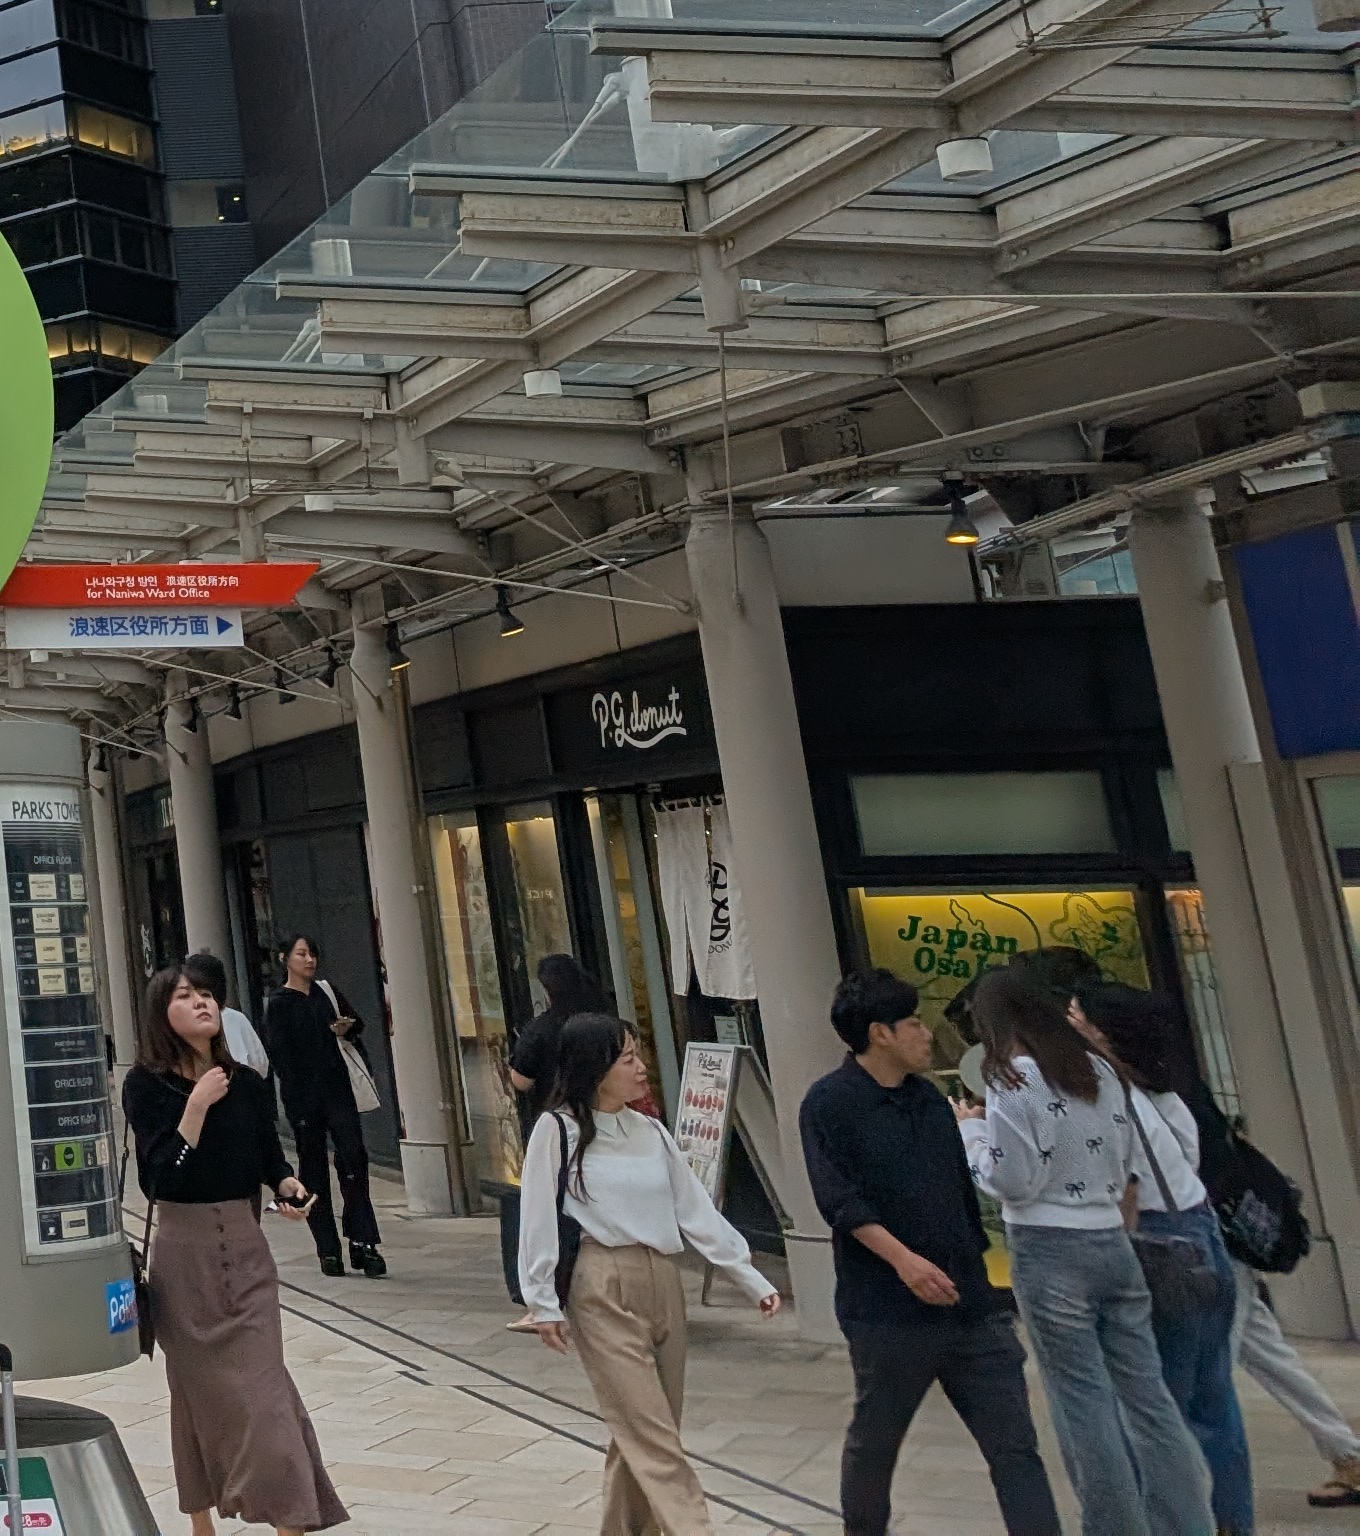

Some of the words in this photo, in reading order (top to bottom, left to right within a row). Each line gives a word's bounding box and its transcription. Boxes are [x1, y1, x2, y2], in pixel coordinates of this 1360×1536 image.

[87, 588, 103, 599] for
[105, 588, 145, 599] Naniwa
[146, 588, 176, 598] Ward
[178, 587, 210, 598] Office
[69, 615, 209, 637] 浪速区役所方面
[12, 801, 53, 820] PARKS
[898, 915, 1018, 955] Japan
